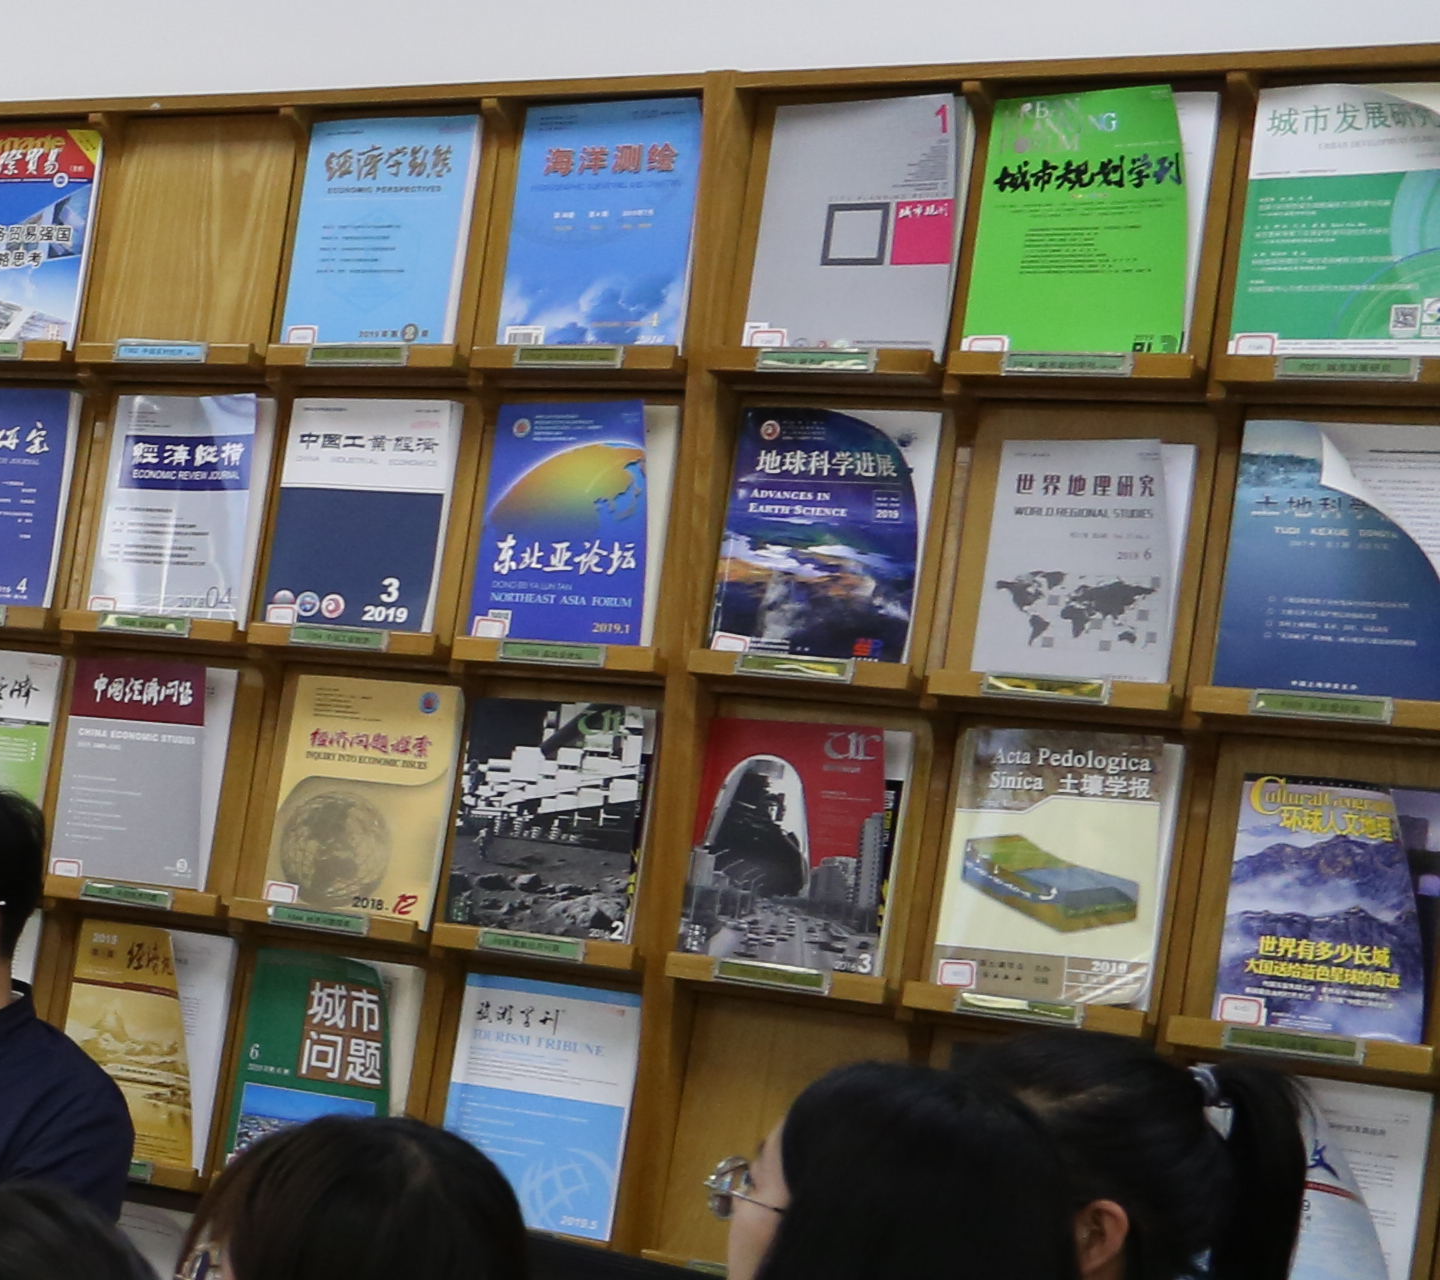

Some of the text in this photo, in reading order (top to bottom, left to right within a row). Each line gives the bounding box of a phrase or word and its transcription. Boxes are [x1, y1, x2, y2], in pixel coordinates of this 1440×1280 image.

[935, 104, 948, 133] 1
[544, 142, 679, 176] 海洋测绘
[993, 152, 1183, 194] 城市规划学刊
[132, 470, 242, 481] ECONOMIC REVIEW JOURNAL
[756, 449, 898, 479] 地球科学进展
[750, 488, 832, 502] ADVANCES IN
[1015, 472, 1157, 498] 世界地理研究
[748, 502, 848, 518] EARTH SCIENCE
[875, 507, 900, 520] 2019
[1014, 506, 1155, 520] WORLD REGIONAL STUDIES
[493, 534, 637, 576] 东北亚论坛
[1143, 548, 1153, 561] 6
[15, 577, 28, 595] 4
[380, 577, 401, 603] 3
[490, 591, 633, 608] NORTHEAST ASIA FORUM
[361, 605, 409, 624] 2019
[592, 622, 631, 634] 2019.1
[78, 727, 196, 745] CHINA ECONOMIC STUDIES
[305, 751, 429, 770] INQUIRY INTO ECONOMIC ISSUES
[995, 747, 1152, 774] Acta Pedologica
[988, 770, 1153, 800] Sinica 土壤学报
[1279, 806, 1394, 842] 环球人文地理
[611, 921, 625, 941] 2
[857, 953, 873, 974] 3
[1257, 935, 1392, 969] 世界有多少长城
[1244, 958, 1401, 990] 大国送给蓝色星球的奇迹
[308, 980, 380, 1032] 城市
[248, 1042, 260, 1061] 6
[472, 1027, 607, 1057] TOURISM TRIBUNE
[298, 1031, 381, 1086] 问题
